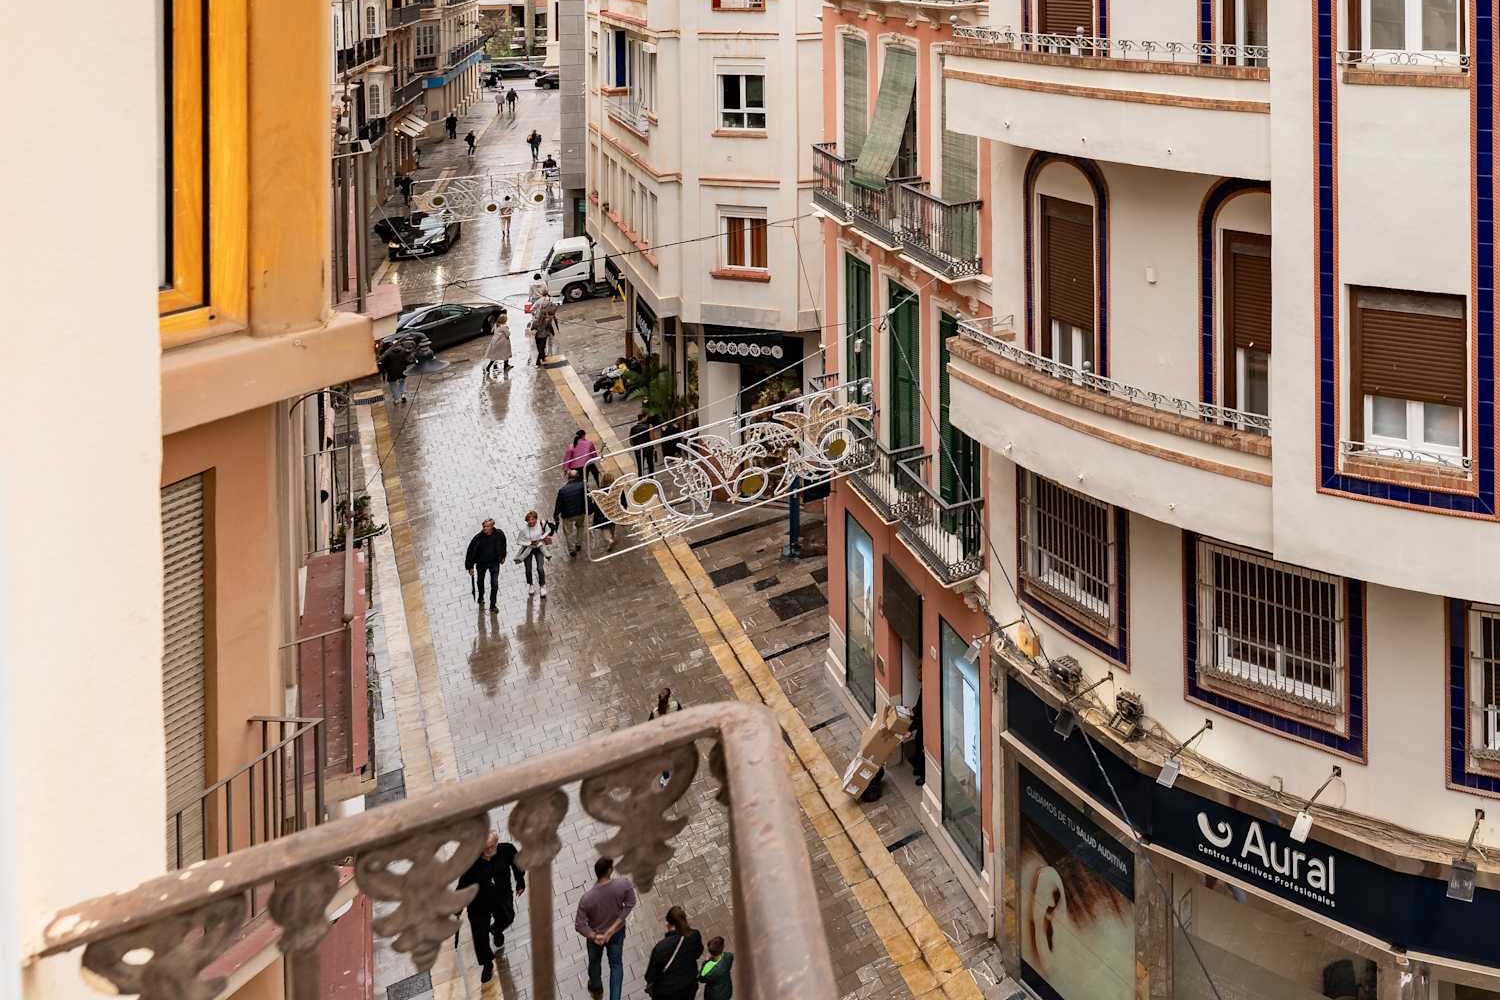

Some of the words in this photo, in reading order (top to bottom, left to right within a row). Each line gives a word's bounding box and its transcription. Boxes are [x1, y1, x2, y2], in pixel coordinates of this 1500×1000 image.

[1026, 786, 1057, 817] CUIDAMOS
[1058, 811, 1067, 825] DE
[1067, 818, 1076, 832] TU
[1076, 826, 1097, 849] SALUD
[1097, 843, 1128, 875] AUDITIVA
[1241, 821, 1335, 895] Aural
[1198, 843, 1230, 863] Centros
[1232, 858, 1272, 880] Auditivos
[1275, 876, 1335, 907] Profesionales
